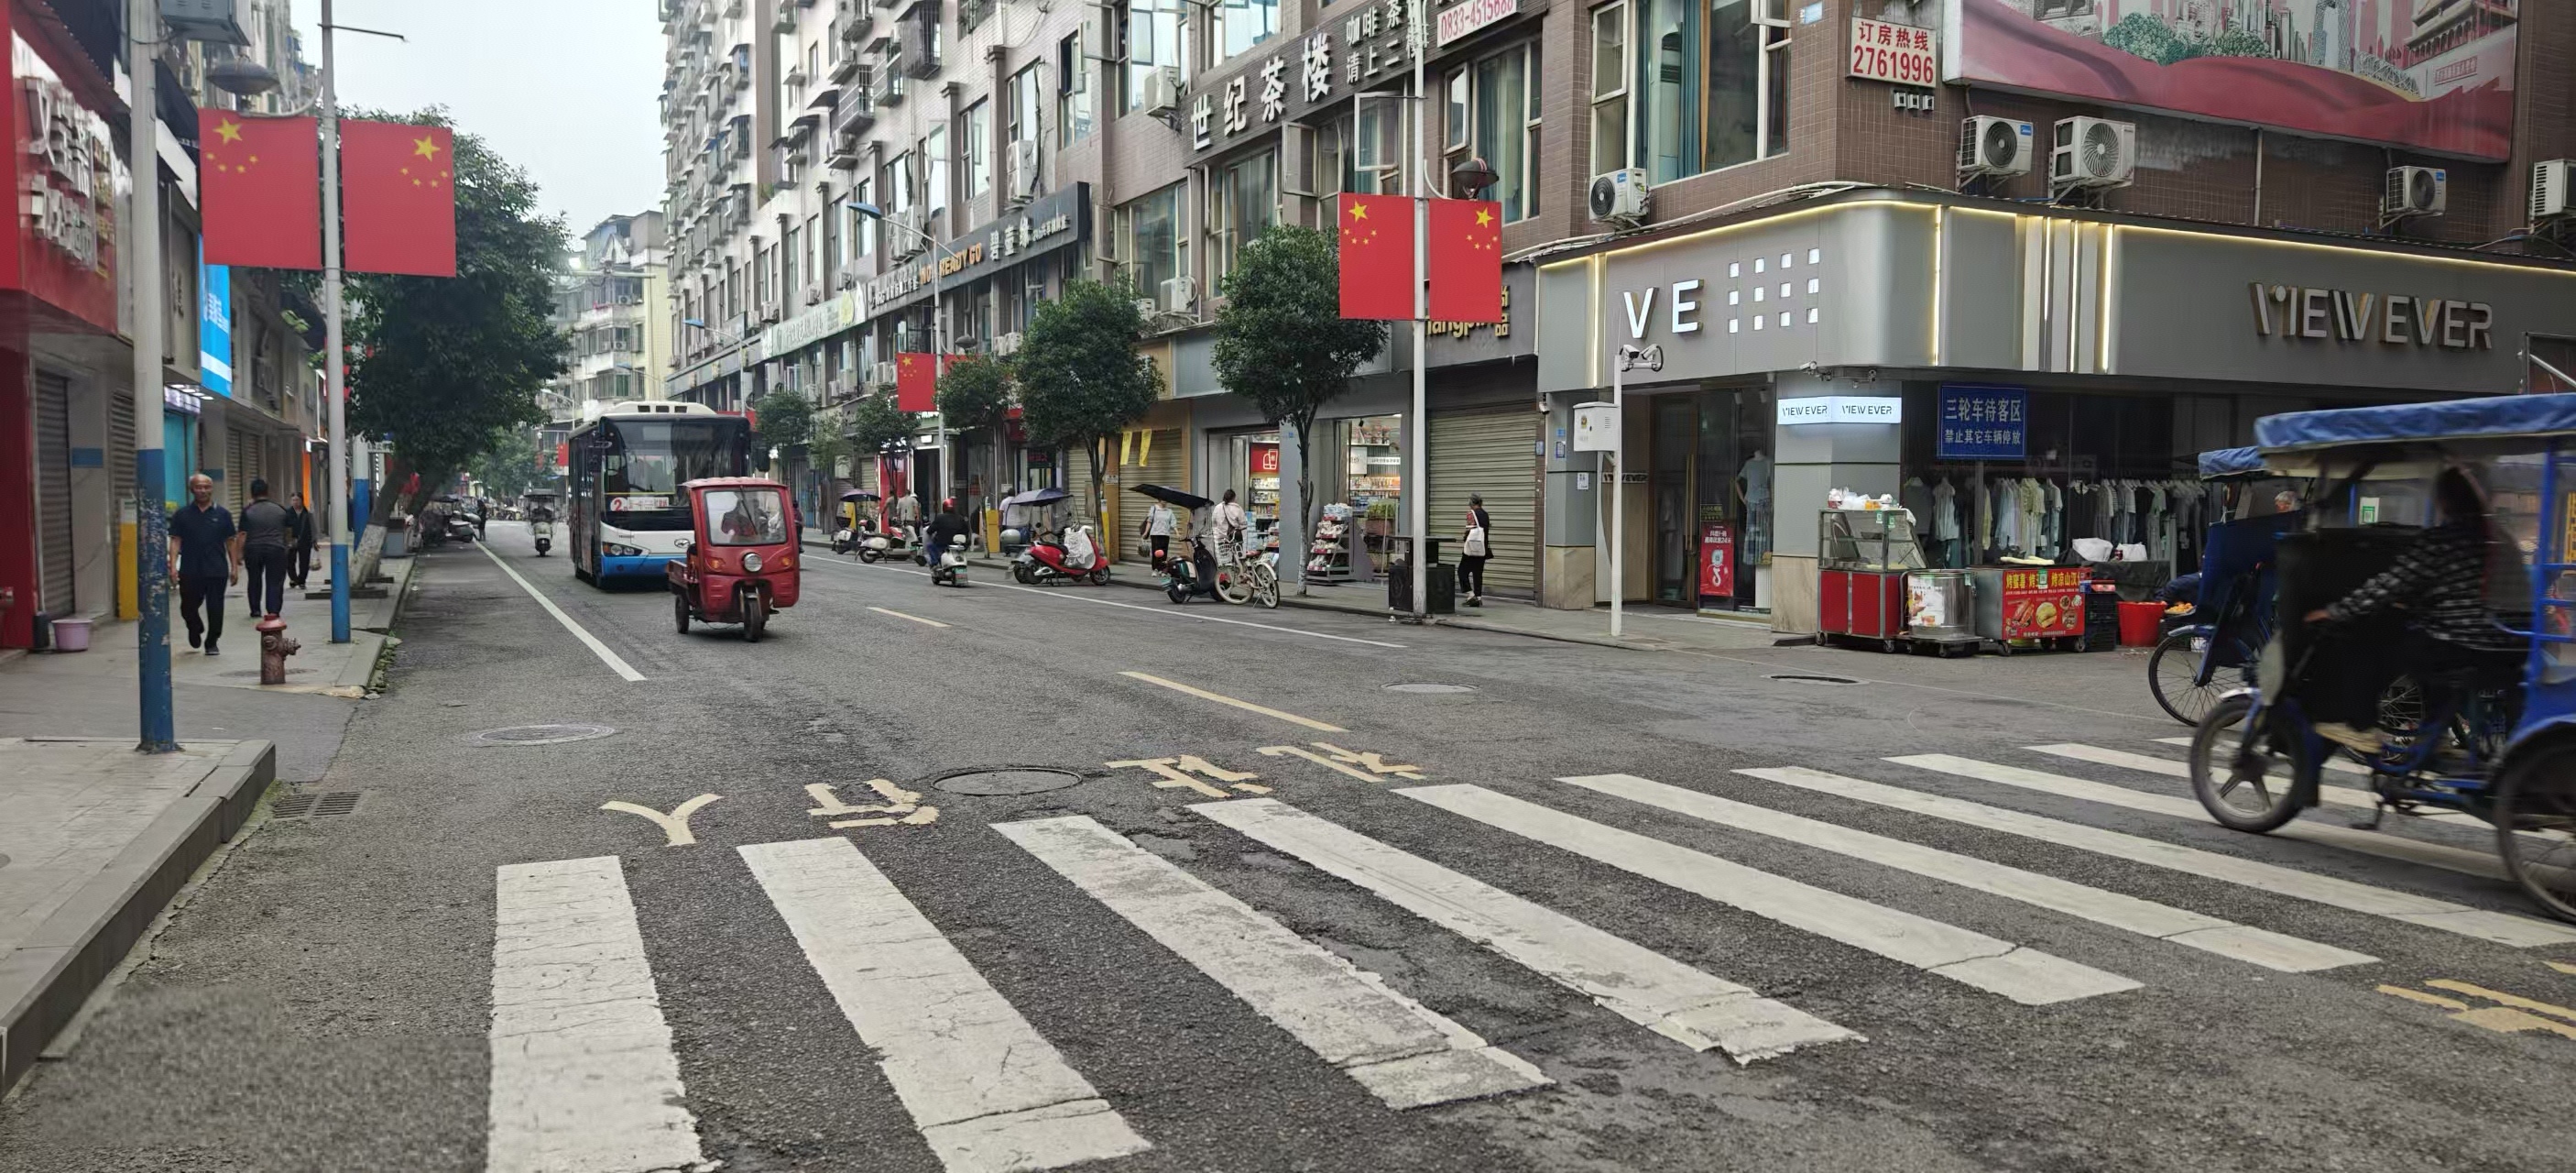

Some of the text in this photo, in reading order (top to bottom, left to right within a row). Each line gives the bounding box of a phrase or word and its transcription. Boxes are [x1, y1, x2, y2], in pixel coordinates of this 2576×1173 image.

[1346, 0, 1423, 47] 咖啡茶
[1859, 21, 1928, 51] 订房热线
[1853, 45, 1933, 83] 2761996
[1191, 33, 1329, 150] 世纪茶楼
[939, 249, 967, 277] READY
[968, 242, 982, 265] GO
[1623, 279, 1702, 339] VE
[2251, 282, 2493, 349] VIEW EVER
[1782, 406, 1828, 416] VIEW EVER
[1842, 405, 1892, 414] VIEW EVER
[1945, 398, 2022, 422] 三轮车待客区
[1944, 429, 2021, 444] 禁止其它车辆停放
